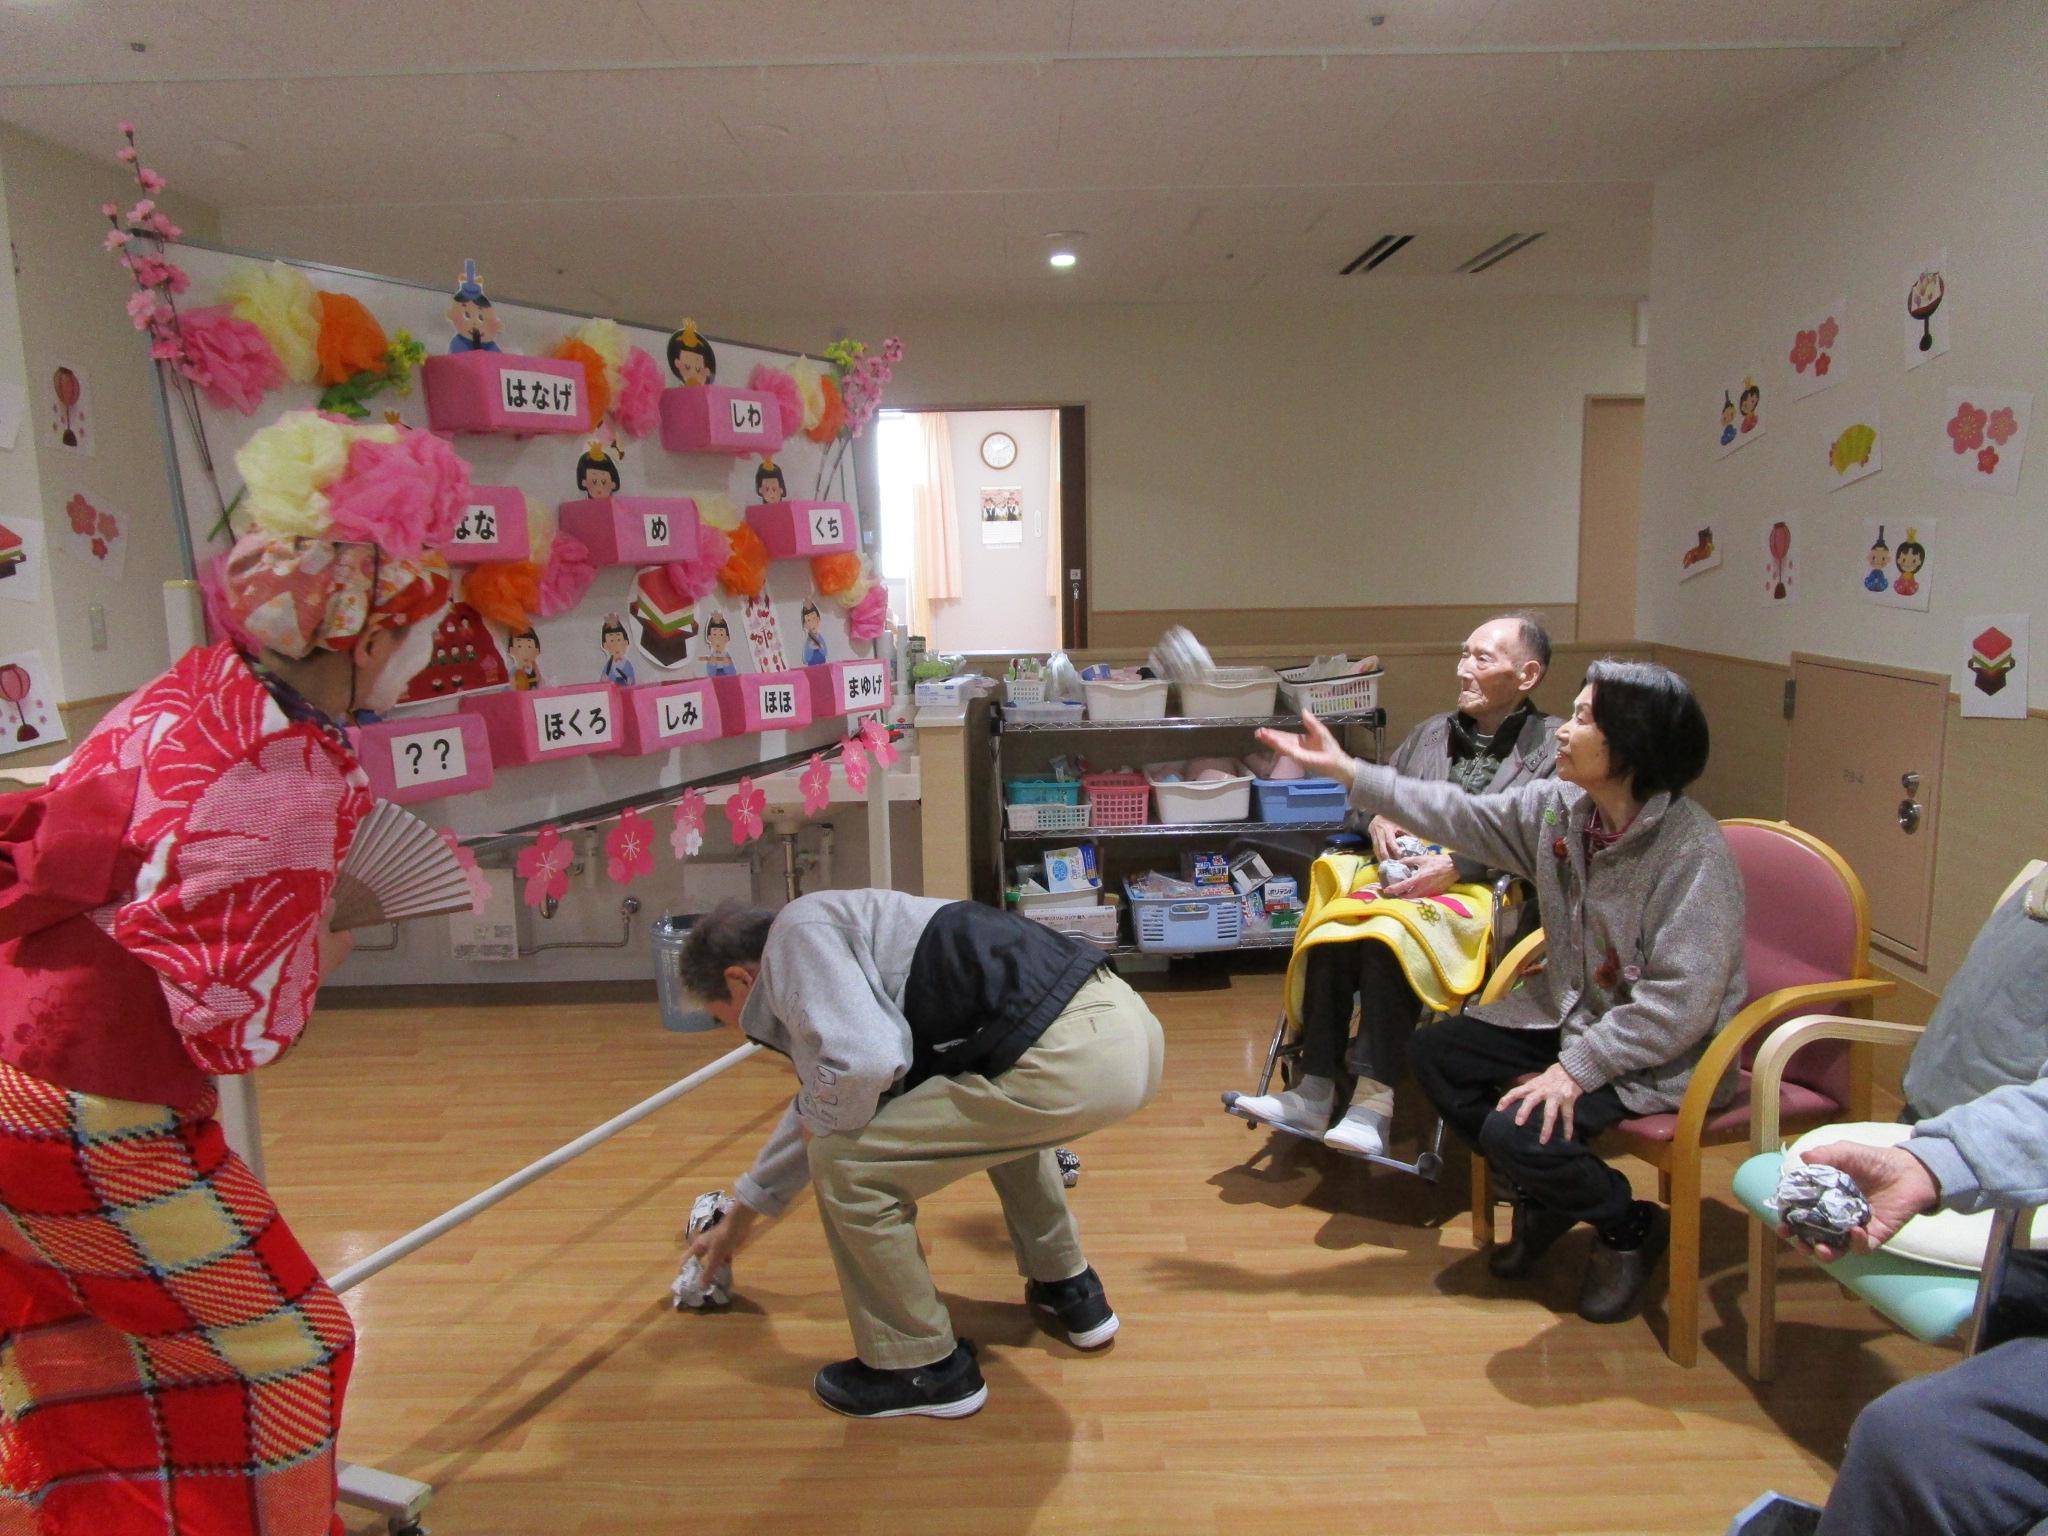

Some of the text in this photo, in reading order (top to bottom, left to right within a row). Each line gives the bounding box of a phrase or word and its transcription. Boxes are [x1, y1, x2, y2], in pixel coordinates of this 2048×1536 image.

[506, 378, 572, 412] はなげ
[733, 403, 761, 428] しわ
[652, 517, 667, 542] め
[815, 516, 839, 539] くち
[848, 675, 883, 699] まゆげ
[764, 691, 792, 714] ほほ
[544, 707, 607, 742] ほくろ
[665, 701, 698, 730] しみ
